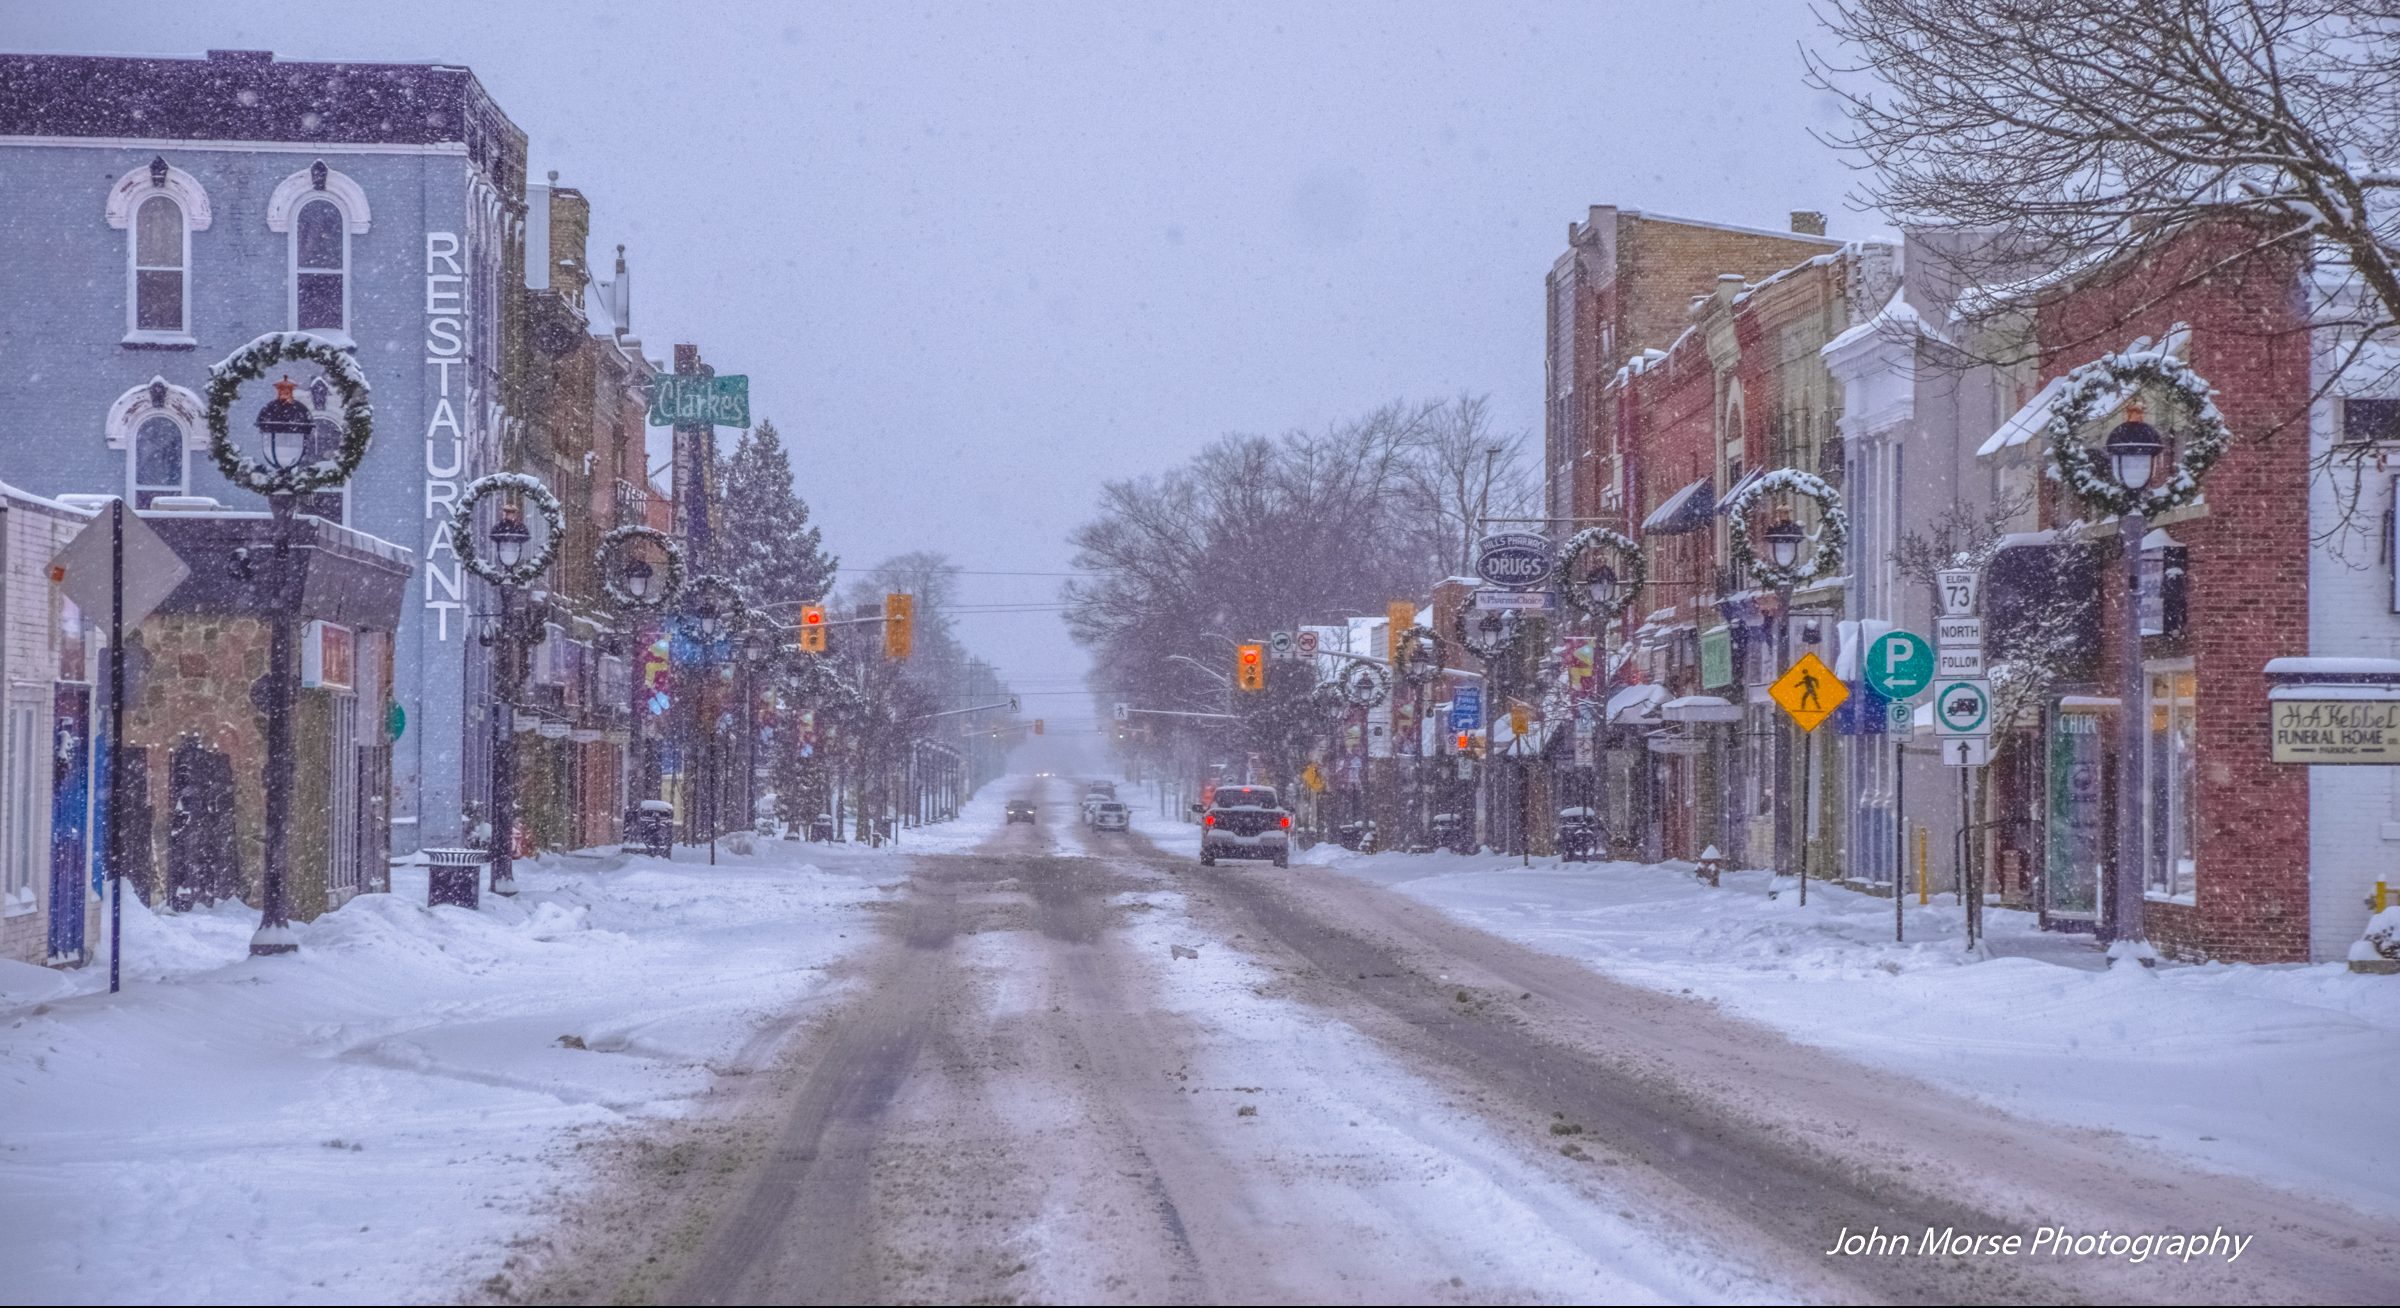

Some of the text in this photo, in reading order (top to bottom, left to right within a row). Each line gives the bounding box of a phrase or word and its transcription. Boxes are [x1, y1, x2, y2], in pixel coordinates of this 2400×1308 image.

[660, 381, 744, 420] Clarkes
[426, 232, 462, 641] RESTAURANT
[1508, 536, 1548, 551] PHARMACY
[1488, 558, 1542, 575] DRUGS
[1946, 586, 1970, 607] 73
[1941, 626, 1979, 637] NORTH
[1886, 638, 1914, 674] P
[1942, 656, 1978, 668] FOLLOW
[1897, 709, 1906, 719] P
[2278, 730, 2336, 744] FUNERAL
[2341, 730, 2383, 745] HOME
